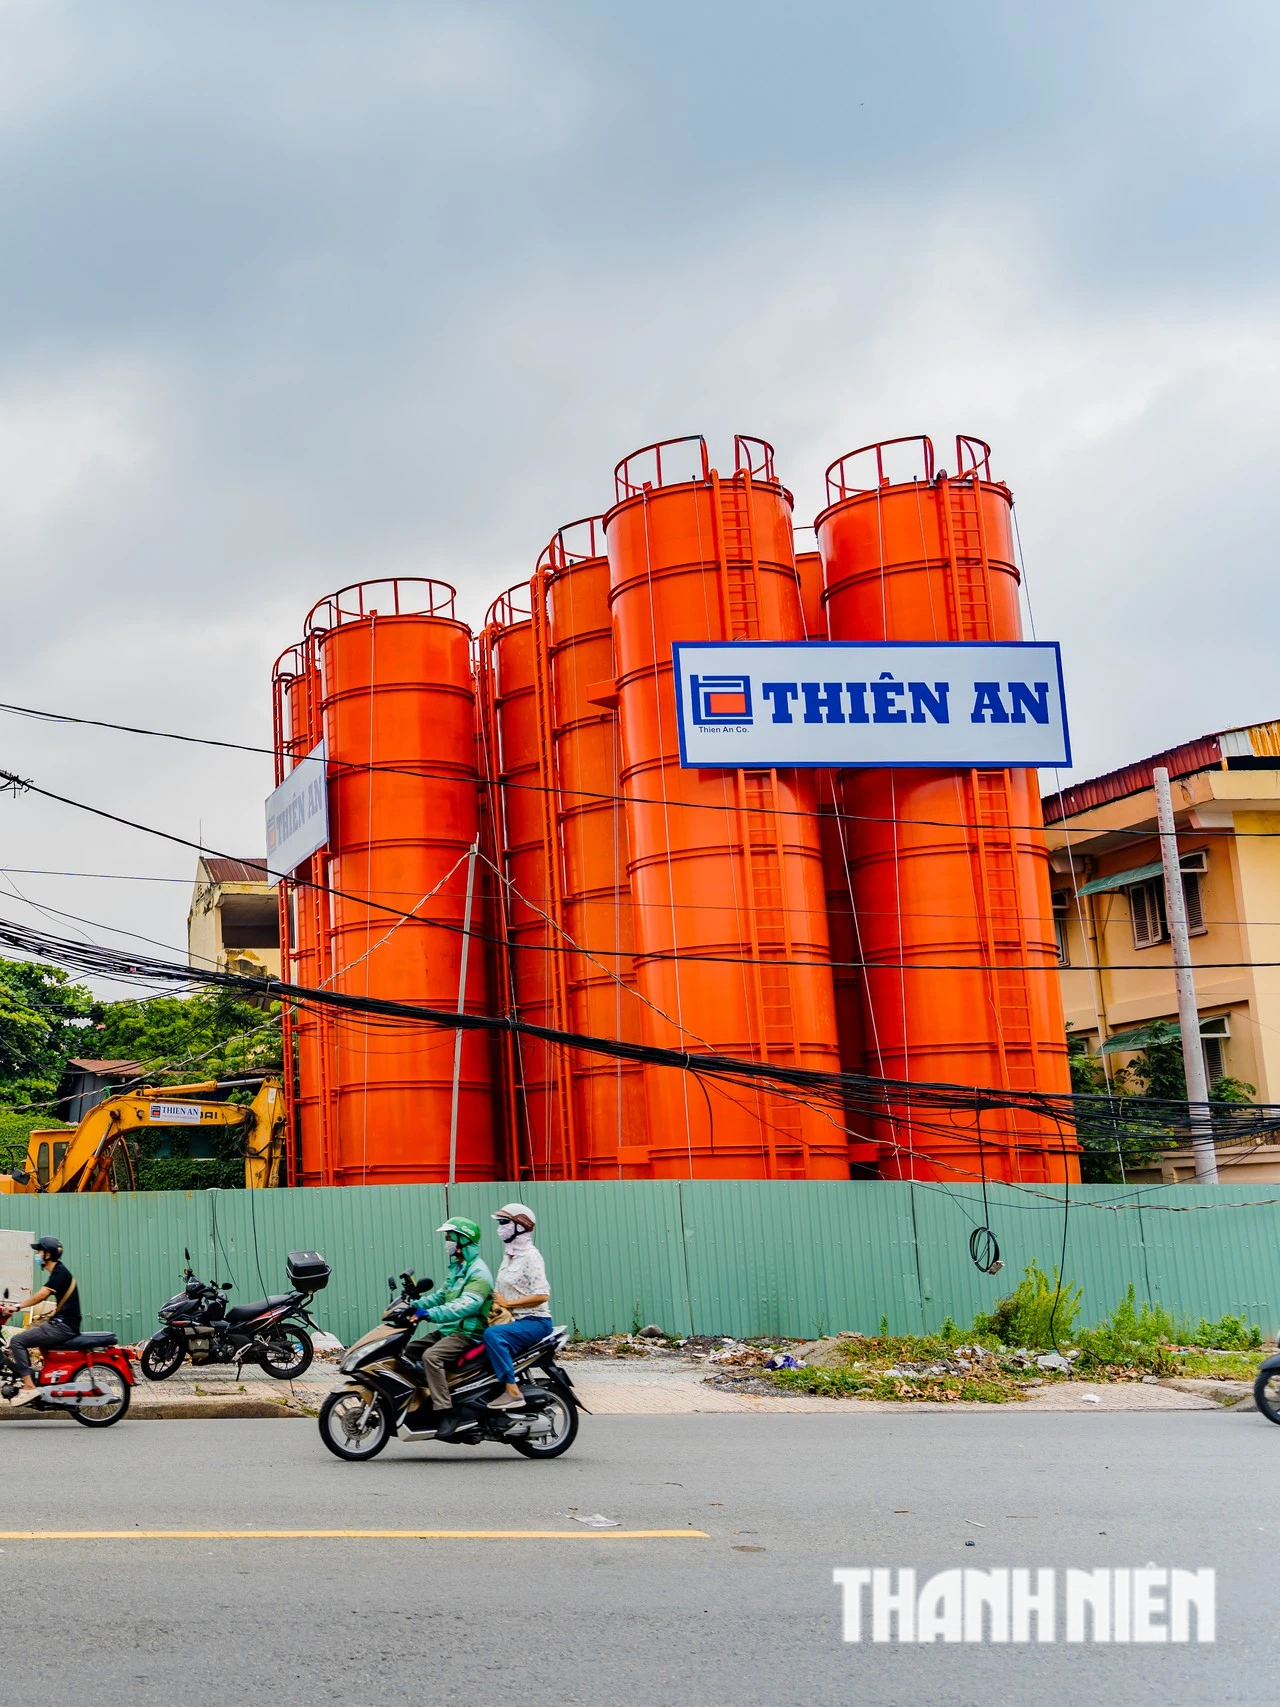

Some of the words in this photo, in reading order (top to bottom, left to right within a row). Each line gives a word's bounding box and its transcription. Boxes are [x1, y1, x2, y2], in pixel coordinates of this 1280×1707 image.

[762, 671, 950, 724] THIÊN
[970, 681, 1050, 724] AN
[698, 725, 721, 734] Thien
[722, 725, 734, 734] An
[736, 725, 750, 734] Co.
[276, 791, 306, 847] THIÊN
[307, 774, 323, 820] AN
[187, 1107, 199, 1116] AN
